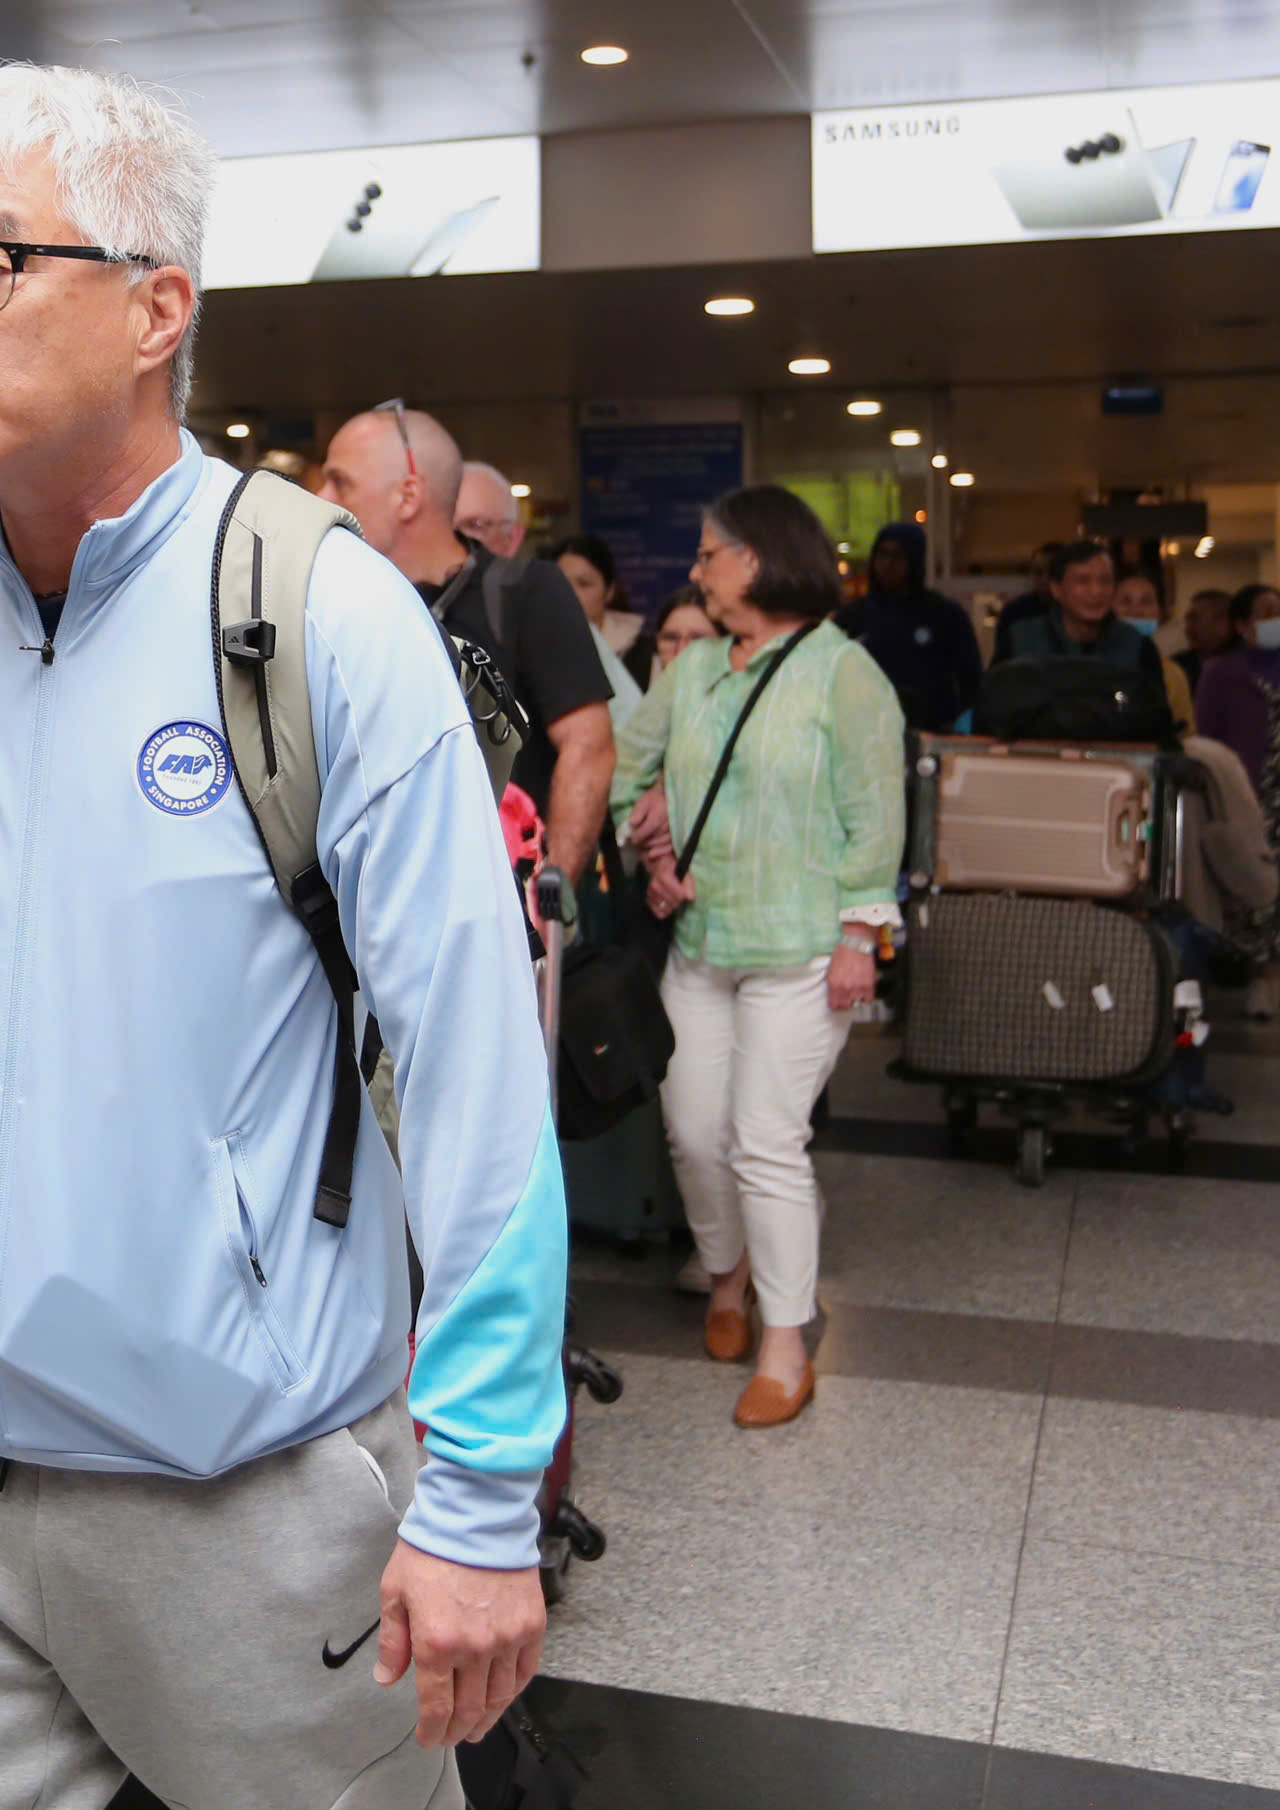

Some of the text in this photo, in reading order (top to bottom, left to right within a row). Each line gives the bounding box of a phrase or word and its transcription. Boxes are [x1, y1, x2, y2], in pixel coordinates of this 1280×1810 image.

[825, 116, 961, 144] SAMSUNG
[143, 726, 226, 785] FOOTBALL ASSOCIATION
[148, 785, 209, 810] SINGAPORE
